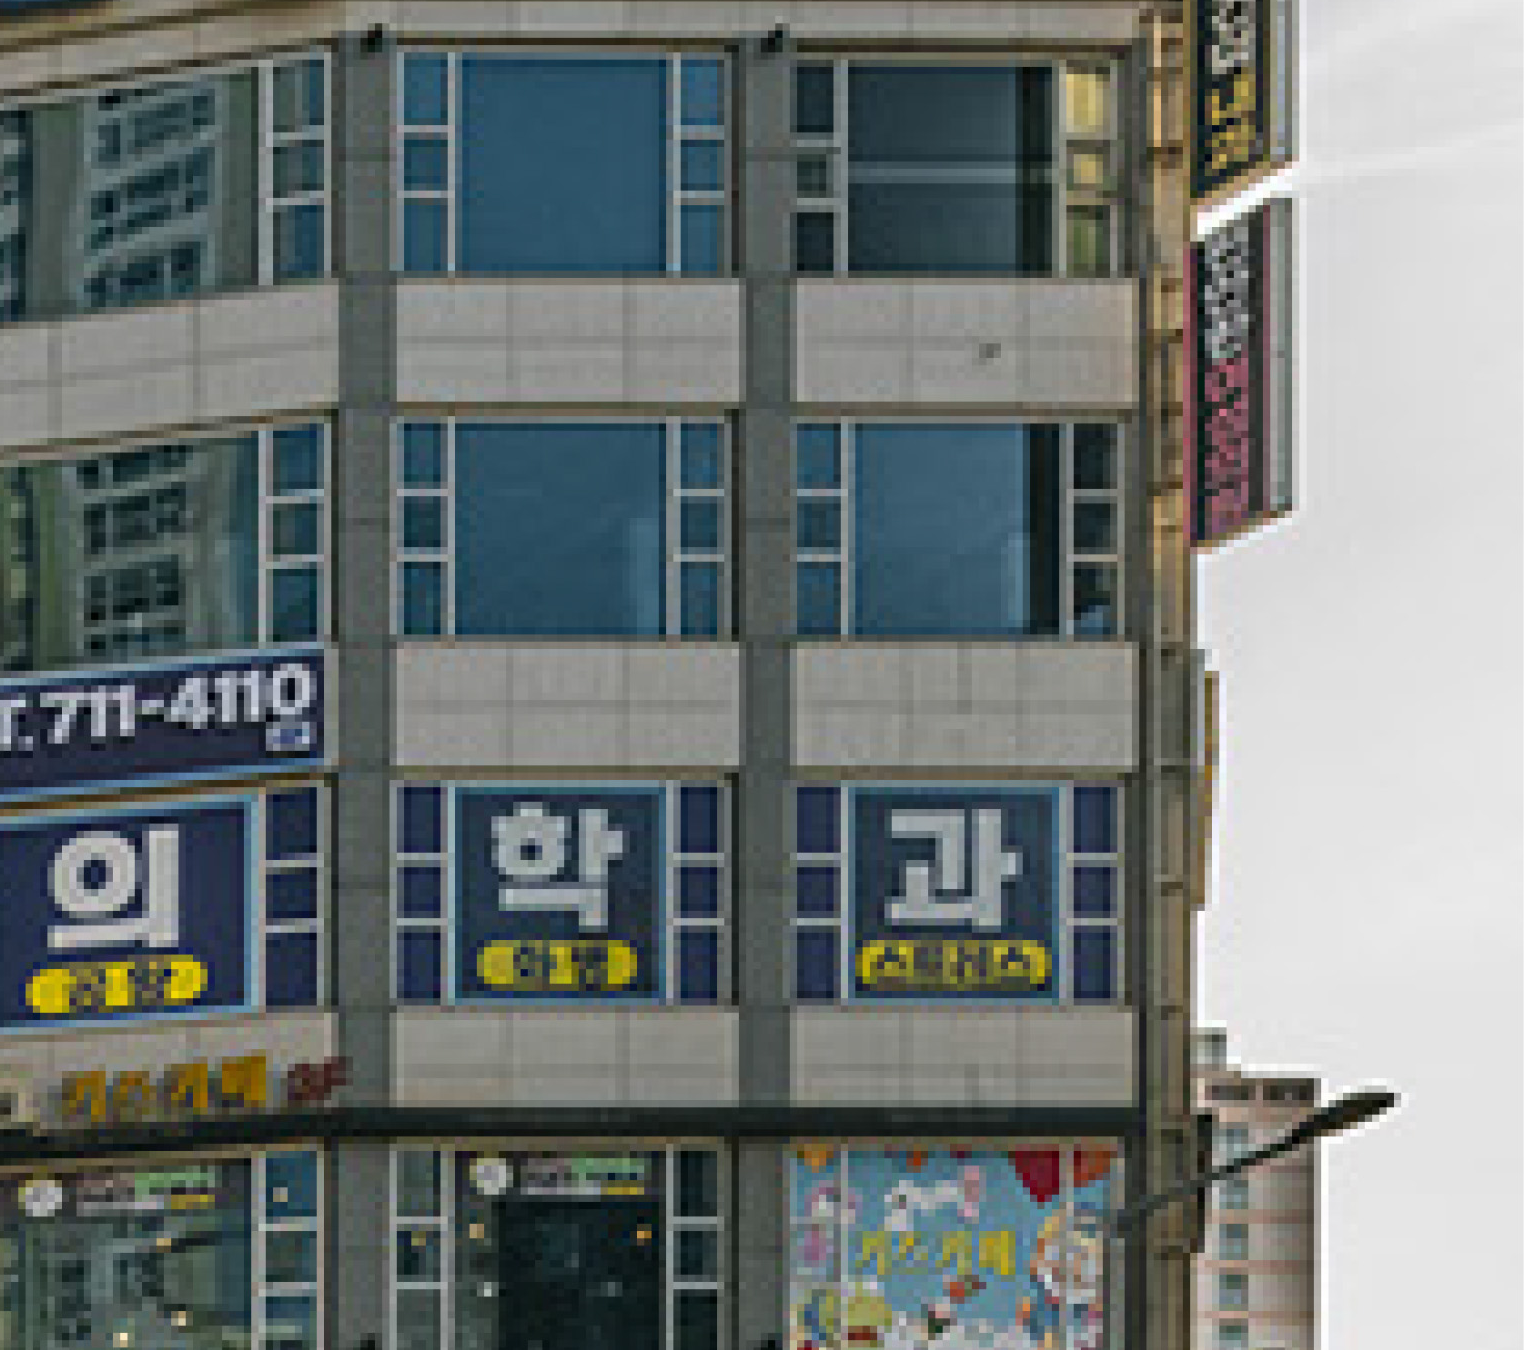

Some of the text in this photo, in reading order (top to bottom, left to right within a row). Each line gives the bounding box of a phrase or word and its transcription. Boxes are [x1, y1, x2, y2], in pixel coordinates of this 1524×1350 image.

[45, 825, 181, 950] 의
[491, 804, 623, 929] 학
[887, 807, 1020, 929] 과
